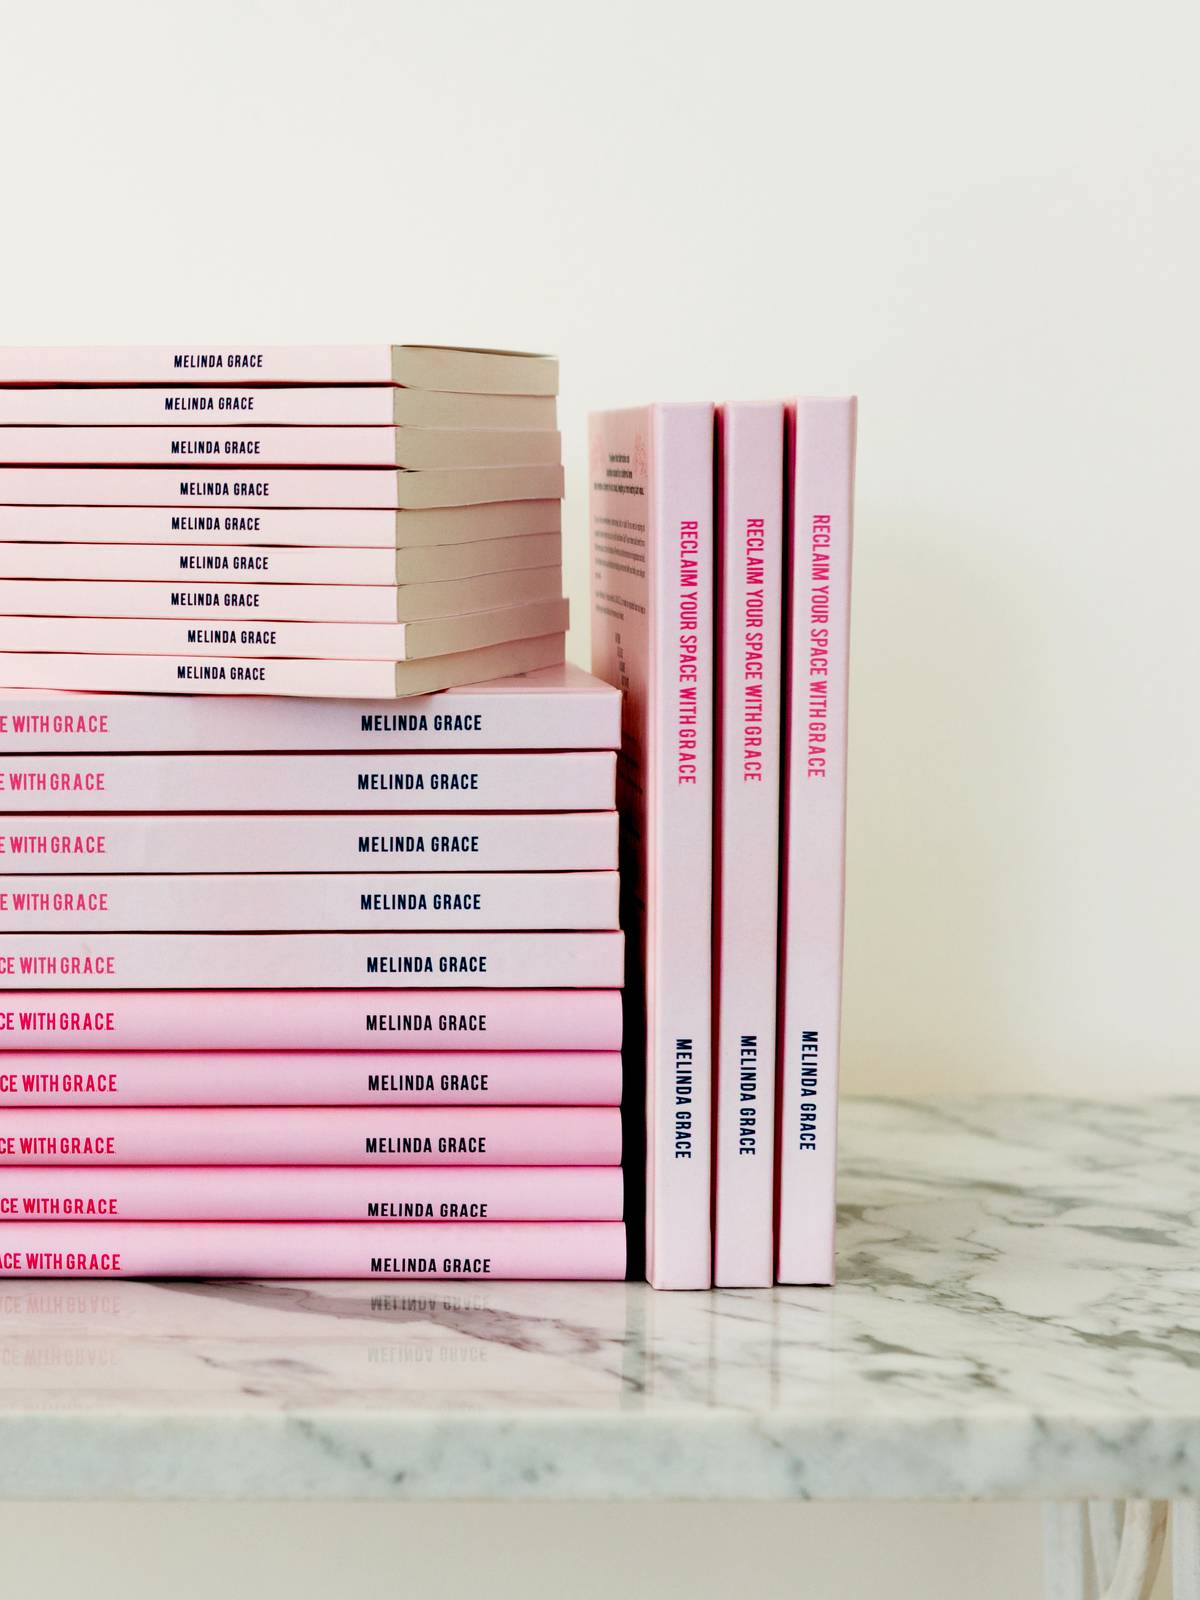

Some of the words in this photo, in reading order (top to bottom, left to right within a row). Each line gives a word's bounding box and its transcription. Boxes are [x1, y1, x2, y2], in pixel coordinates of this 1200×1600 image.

[173, 354, 223, 369] MELINDA
[227, 354, 264, 368] GRACE
[164, 396, 214, 411] MELINDA
[218, 396, 255, 411] GRACE
[170, 440, 221, 455] MELINDA
[224, 440, 261, 455] GRACE
[179, 481, 230, 496] MELINDA
[233, 482, 270, 497] GRACE
[171, 516, 221, 531] MELINDA
[224, 516, 261, 531] GRACE
[679, 520, 700, 588] RECLAIM
[745, 517, 765, 585] RECLAIM
[810, 514, 832, 581] RECLAIM
[179, 555, 229, 570] MELINDA
[232, 556, 269, 570] GRACE
[170, 592, 220, 607] MELINDA
[223, 593, 260, 608] GRACE
[745, 588, 765, 629] YOUR
[810, 584, 830, 624] YOUR
[679, 590, 699, 631] YOUR
[187, 629, 237, 644] MELINDA
[240, 630, 277, 645] GRACE
[678, 634, 699, 683] SPACE
[744, 631, 764, 681] SPACE
[809, 627, 830, 677] SPACE
[177, 665, 227, 680] MELINDA
[229, 666, 266, 681] GRACE
[677, 686, 698, 726] WITH
[743, 683, 764, 723] WITH
[808, 679, 829, 719] WITH
[11, 714, 50, 734] WITH
[361, 714, 429, 732] MELINDA
[433, 714, 482, 732] GRACE
[8, 772, 47, 792] WITH
[357, 773, 425, 791] MELINDA
[430, 773, 479, 791] GRACE
[8, 835, 48, 854] WITH
[358, 836, 425, 853] MELINDA
[430, 835, 479, 853] GRACE
[11, 892, 50, 912] WITH
[360, 893, 428, 911] MELINDA
[432, 893, 482, 911] GRACE
[18, 956, 57, 975] WITH
[366, 956, 434, 973] MELINDA
[438, 955, 487, 973] GRACE
[18, 1011, 57, 1031] WITH
[366, 1014, 433, 1031] MELINDA
[438, 1014, 487, 1032] GRACE
[675, 1038, 693, 1106] MELINDA
[739, 1035, 758, 1102] MELINDA
[800, 1030, 819, 1097] MELINDA
[21, 1074, 60, 1093] WITH
[368, 1074, 435, 1092] MELINDA
[440, 1074, 489, 1091] GRACE
[674, 1110, 692, 1159] GRACE
[738, 1107, 757, 1156] GRACE
[799, 1102, 817, 1151] GRACE
[18, 1136, 57, 1155] WITH
[365, 1137, 433, 1154] MELINDA
[438, 1136, 487, 1154] GRACE
[22, 1197, 60, 1215] WITH
[367, 1202, 434, 1218] MELINDA
[439, 1202, 488, 1218] GRACE
[25, 1252, 63, 1270] WITH
[370, 1257, 437, 1273] MELINDA
[442, 1258, 491, 1273] GRACE
